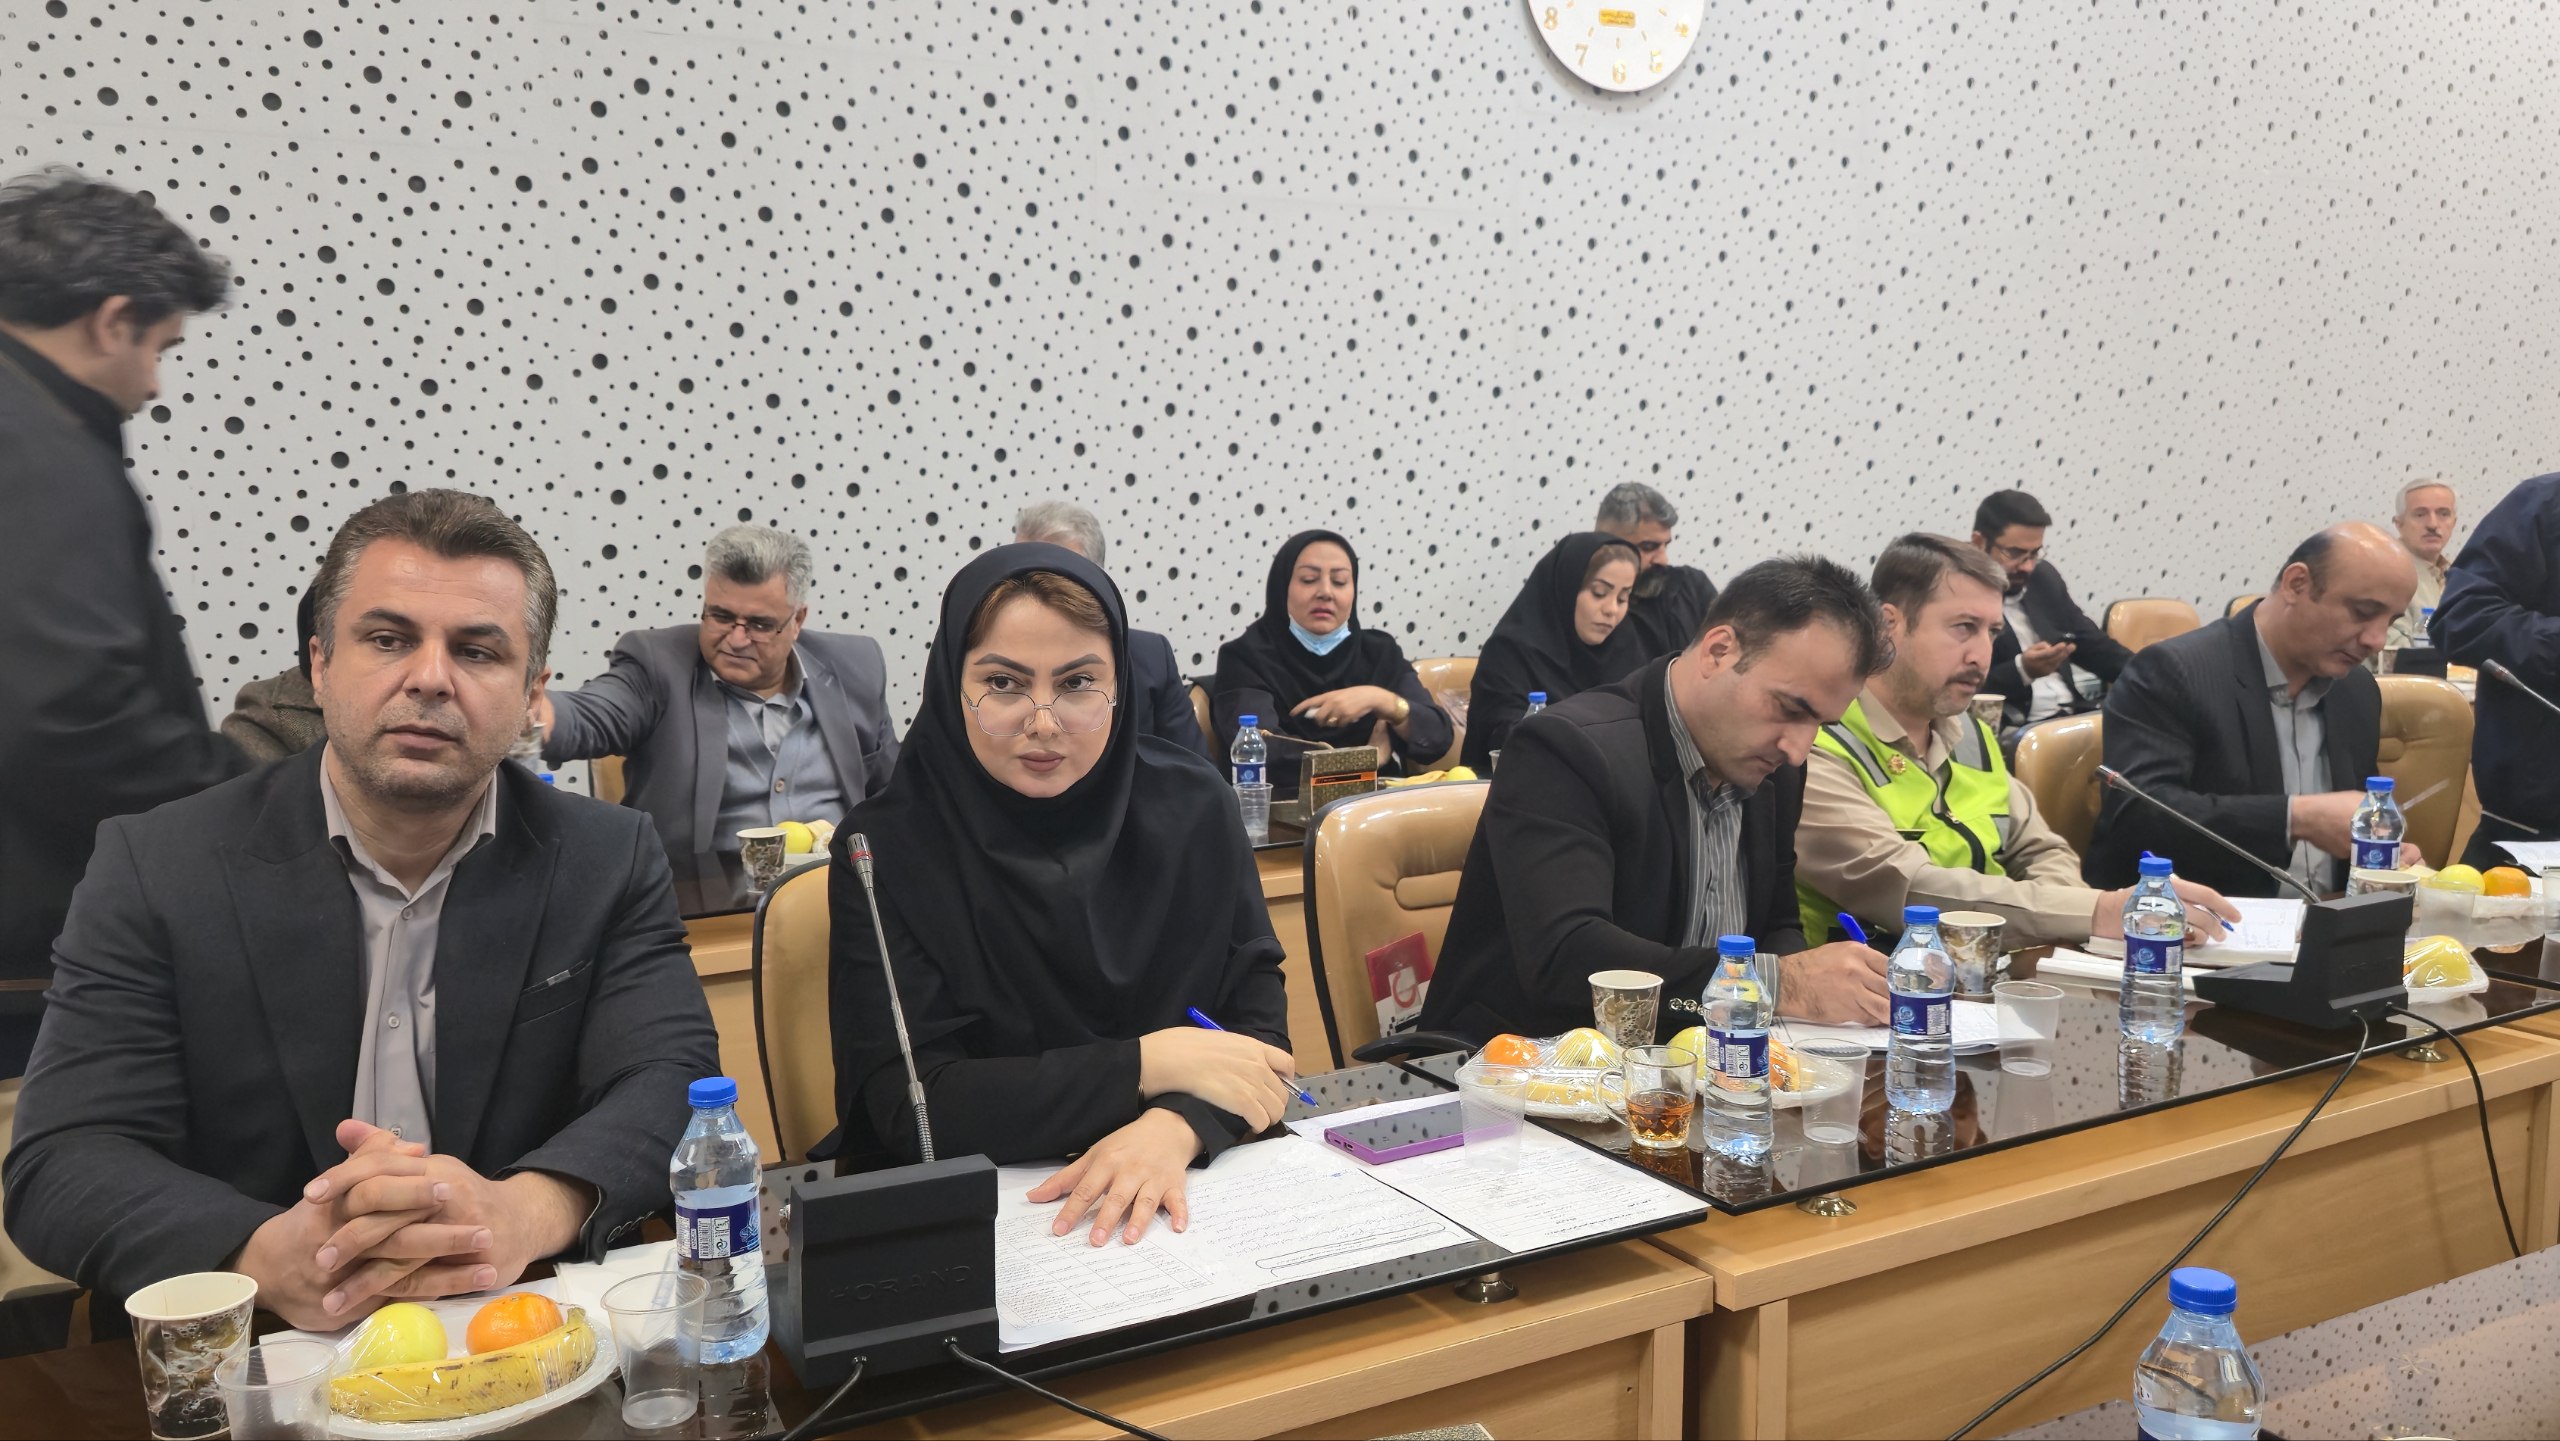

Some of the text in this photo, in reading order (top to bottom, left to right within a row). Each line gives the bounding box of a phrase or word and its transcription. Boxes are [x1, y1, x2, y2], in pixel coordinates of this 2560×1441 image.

[1543, 6, 1559, 31] 8
[1575, 43, 1589, 67] 7
[1612, 60, 1626, 84] 6
